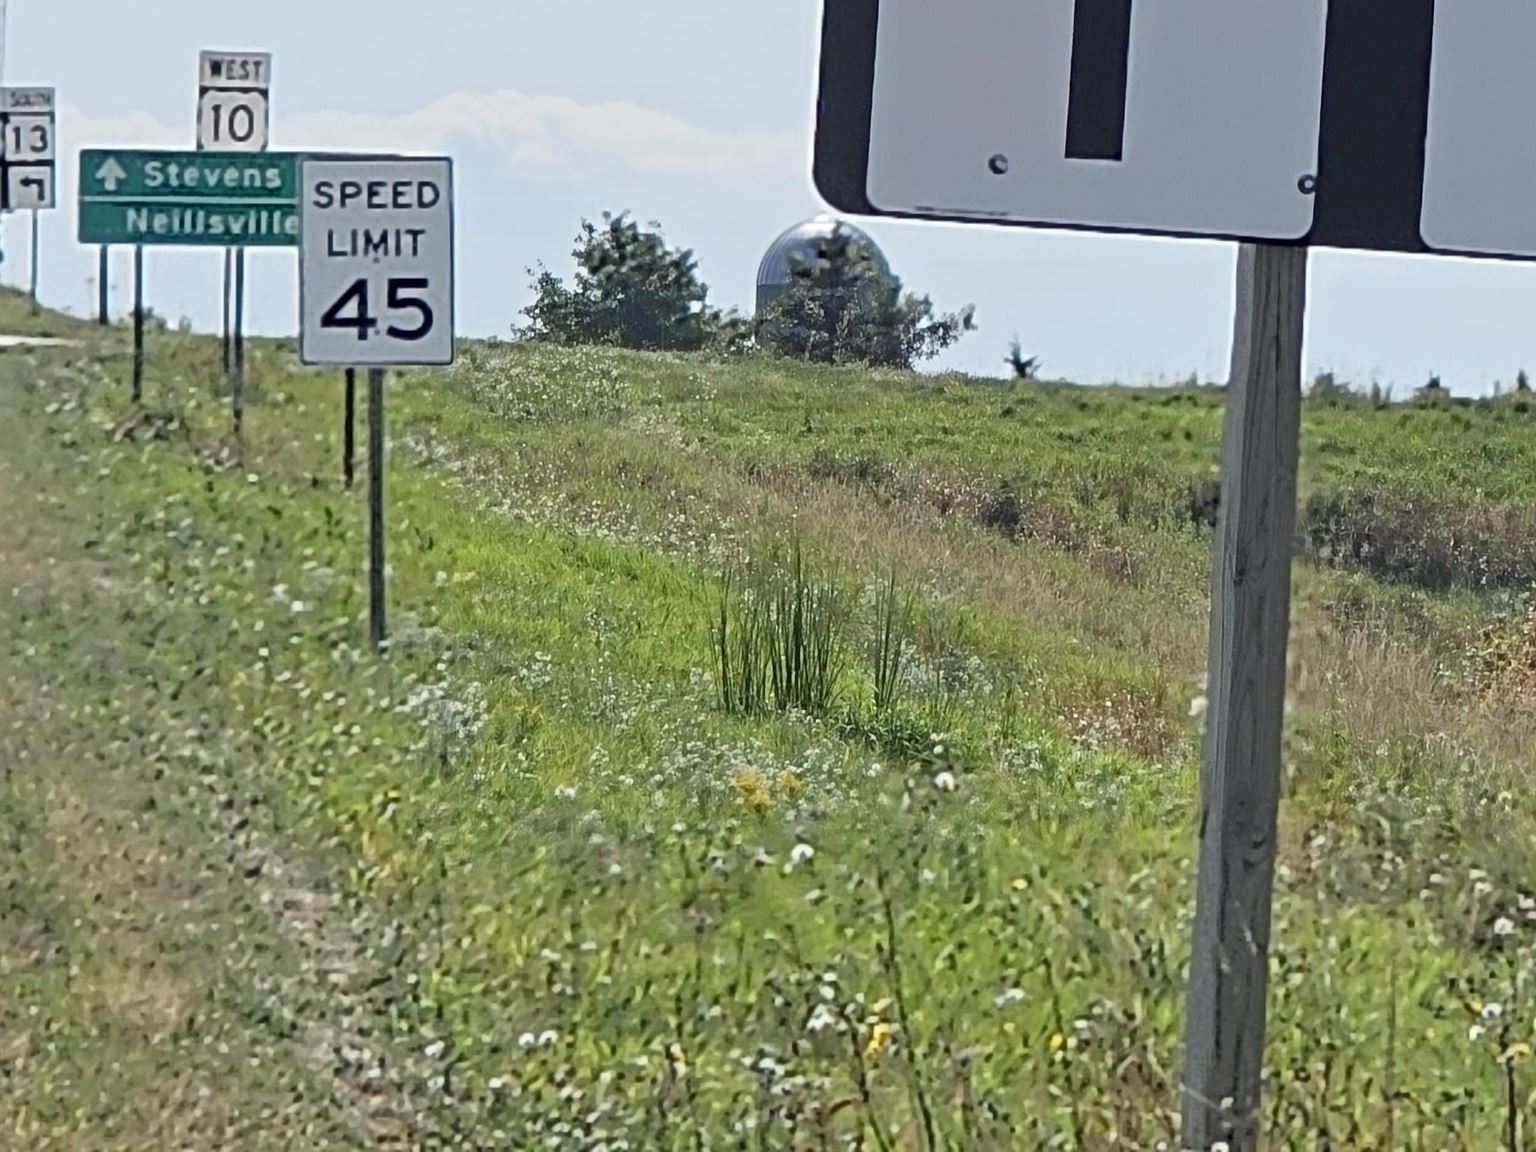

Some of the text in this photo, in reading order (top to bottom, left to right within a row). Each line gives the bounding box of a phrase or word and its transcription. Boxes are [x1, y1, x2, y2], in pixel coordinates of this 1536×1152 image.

[208, 57, 263, 80] WEST
[211, 103, 254, 143] 10
[12, 124, 48, 154] 13
[144, 161, 281, 189] Stevens
[312, 180, 441, 210] SPEED
[126, 207, 299, 236] Neillsville
[326, 228, 426, 258] LIMIT
[319, 277, 434, 342] 45
